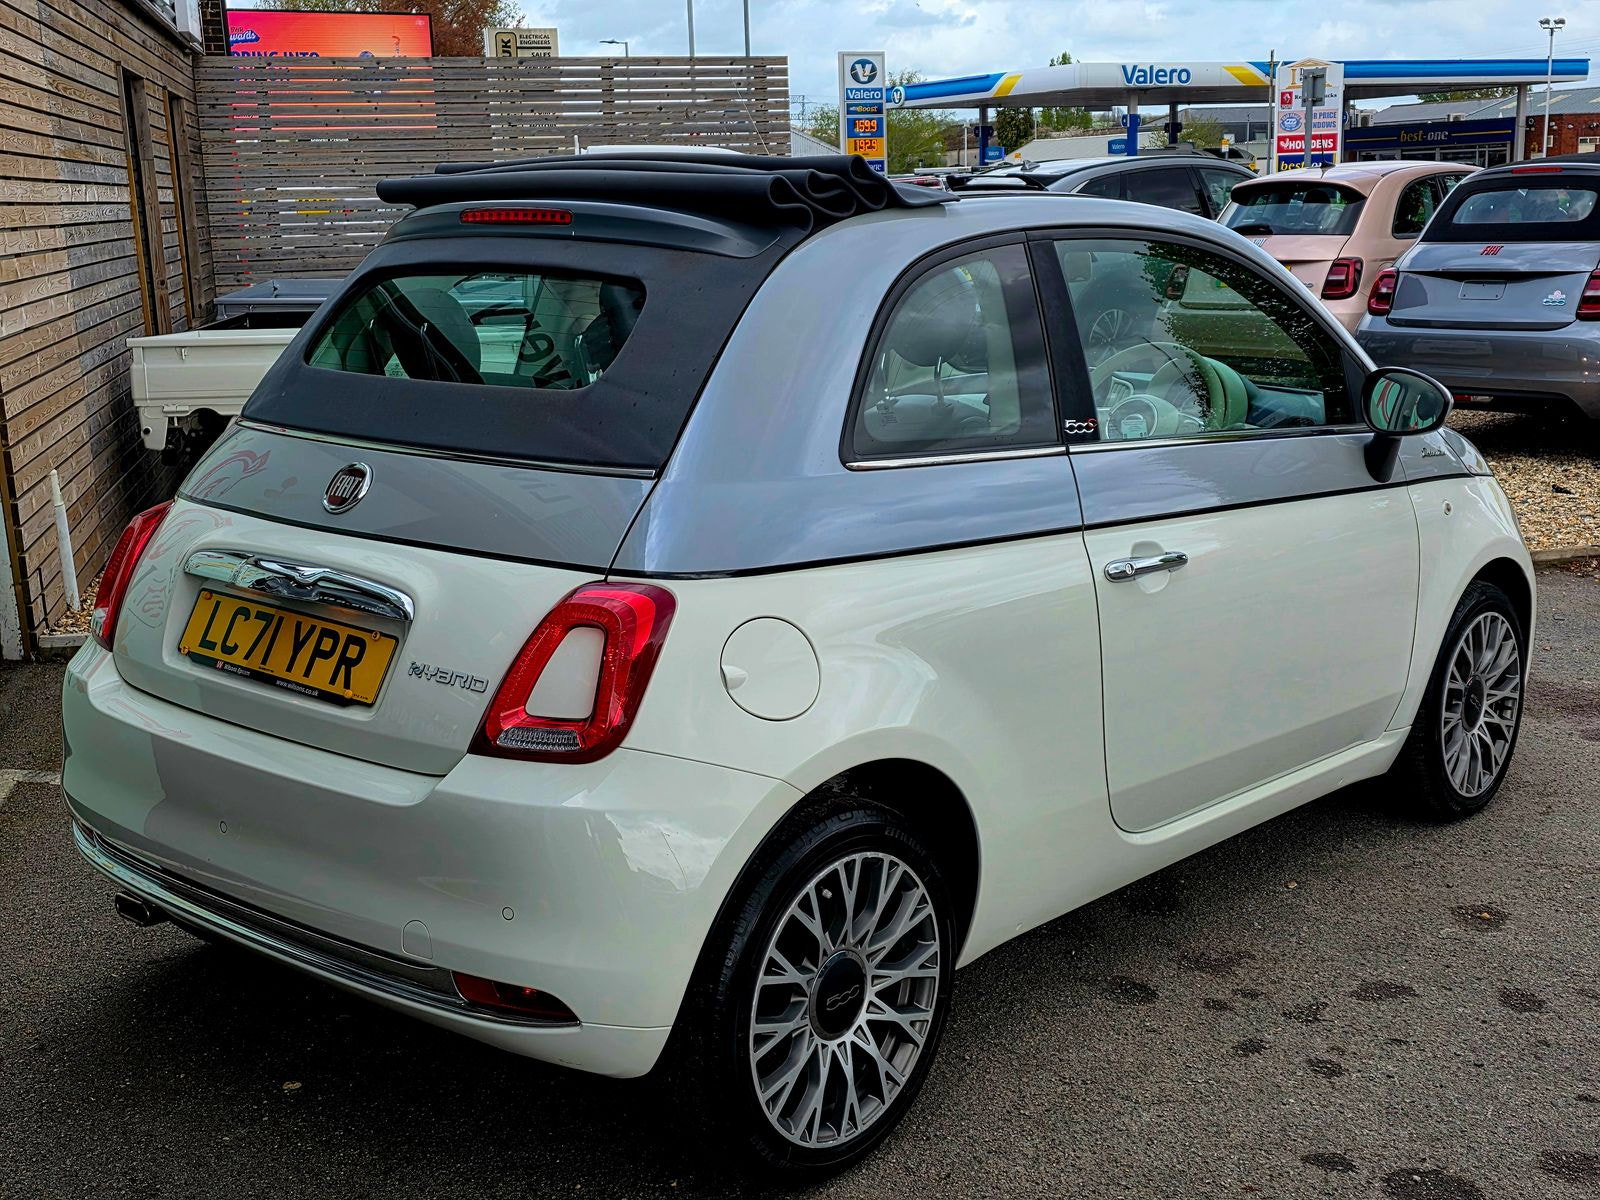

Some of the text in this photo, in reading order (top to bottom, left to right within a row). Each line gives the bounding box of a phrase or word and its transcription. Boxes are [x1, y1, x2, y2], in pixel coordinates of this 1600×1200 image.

[1121, 65, 1191, 84] Valero
[847, 89, 881, 99] Valero
[1289, 138, 1334, 149] HODENS
[1400, 130, 1449, 142] best-one
[331, 475, 362, 499] FIAT
[198, 600, 367, 690] LC71 YPR
[408, 661, 489, 694] HYBRID
